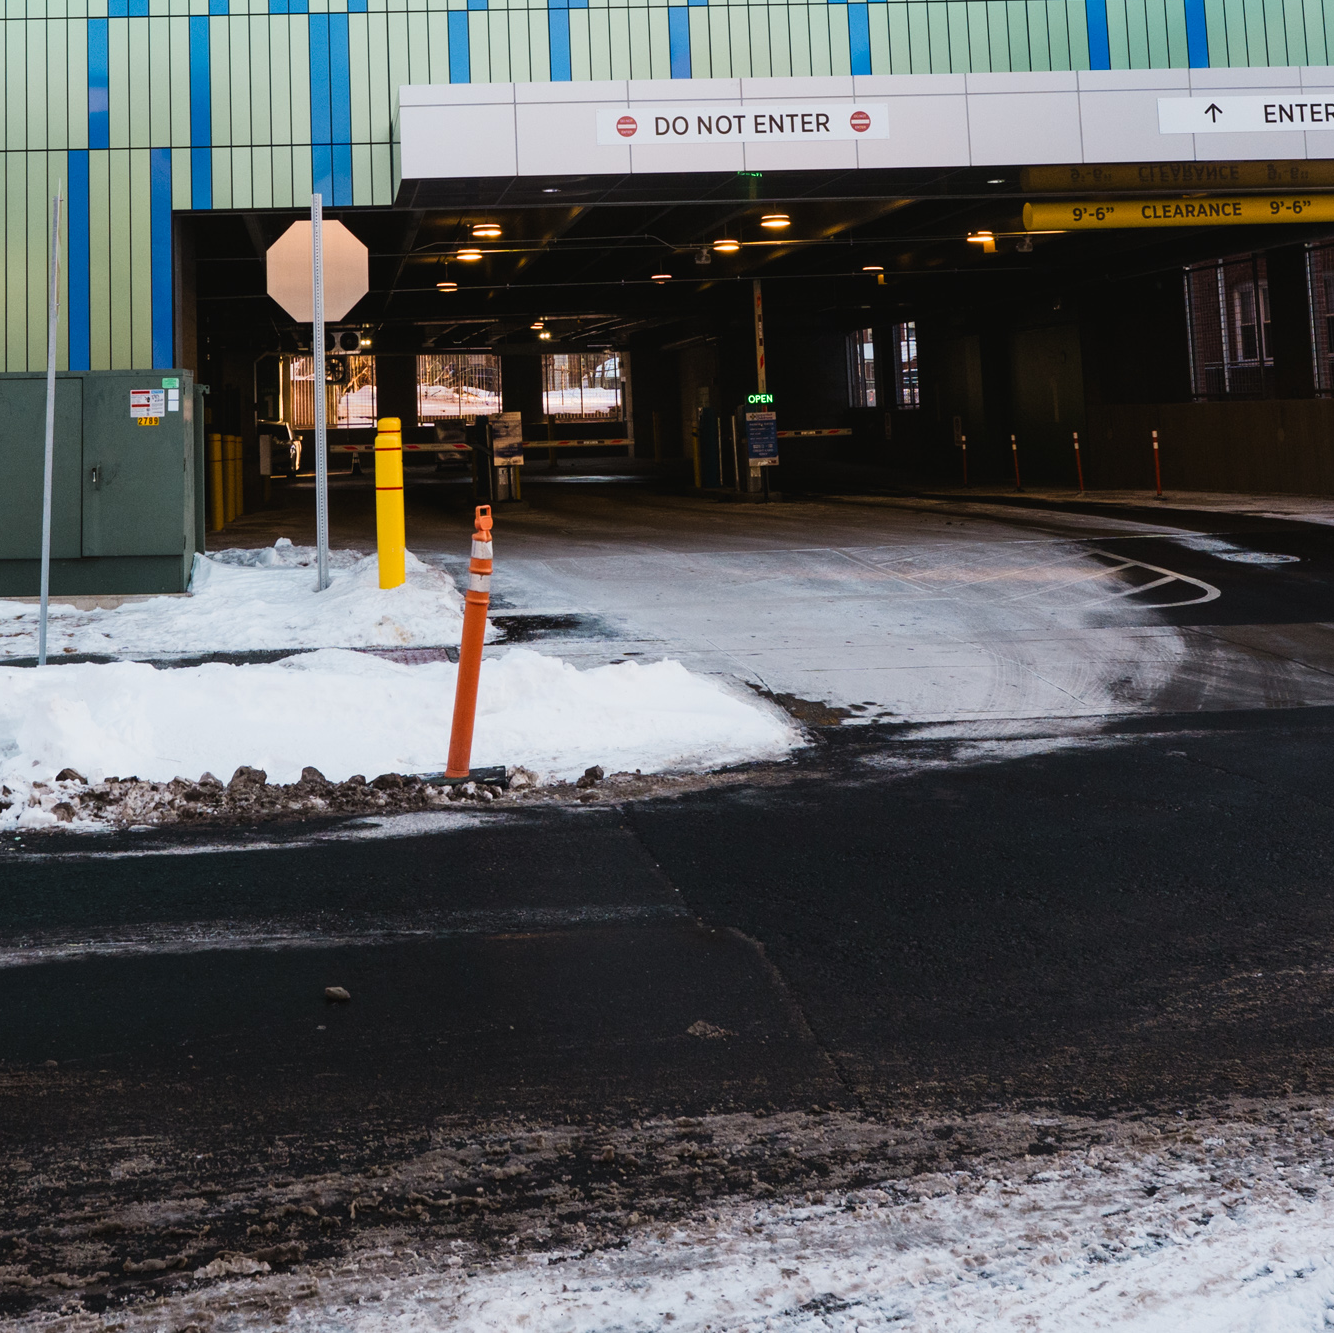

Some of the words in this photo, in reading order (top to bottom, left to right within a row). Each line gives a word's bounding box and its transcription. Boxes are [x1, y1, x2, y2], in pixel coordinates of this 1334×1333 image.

[655, 116, 689, 135] DO
[697, 115, 745, 135] NOT
[754, 113, 830, 133] ENTER
[1141, 202, 1242, 219] CLEARANCE
[748, 394, 773, 404] OPEN
[138, 417, 158, 425] 2789
